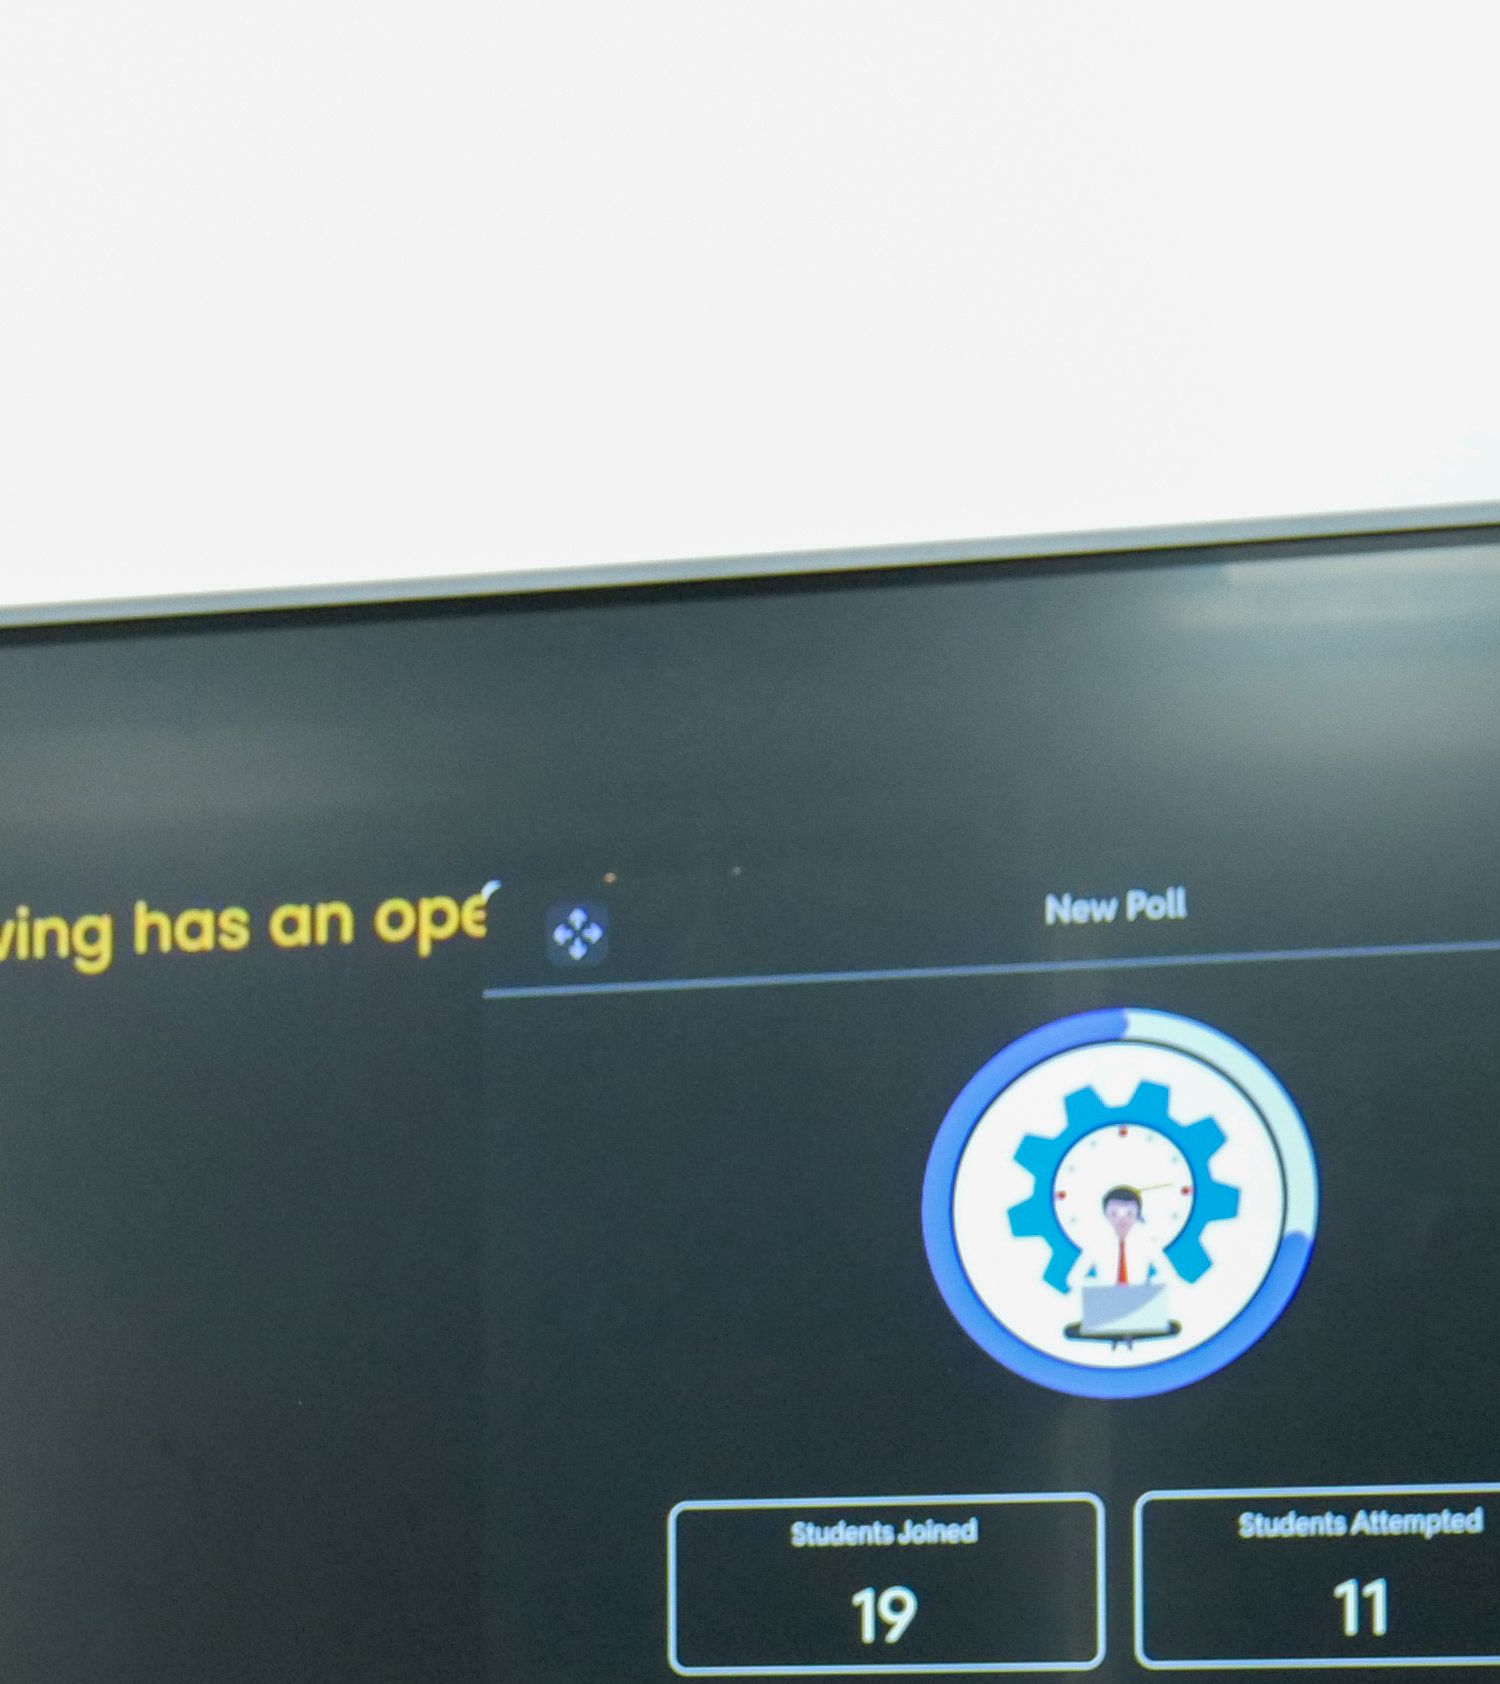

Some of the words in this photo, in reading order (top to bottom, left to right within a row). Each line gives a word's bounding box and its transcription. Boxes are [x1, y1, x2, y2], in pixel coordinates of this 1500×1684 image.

[133, 899, 250, 955] has
[269, 900, 354, 948] an
[1044, 892, 1119, 926] New
[1125, 886, 1188, 922] Poll
[790, 1519, 894, 1548] Students
[896, 1516, 979, 1546] Joined
[1237, 1510, 1348, 1539] Students
[1351, 1506, 1484, 1540] Attempted
[851, 1585, 918, 1644] 19
[1333, 1577, 1387, 1637] 11
